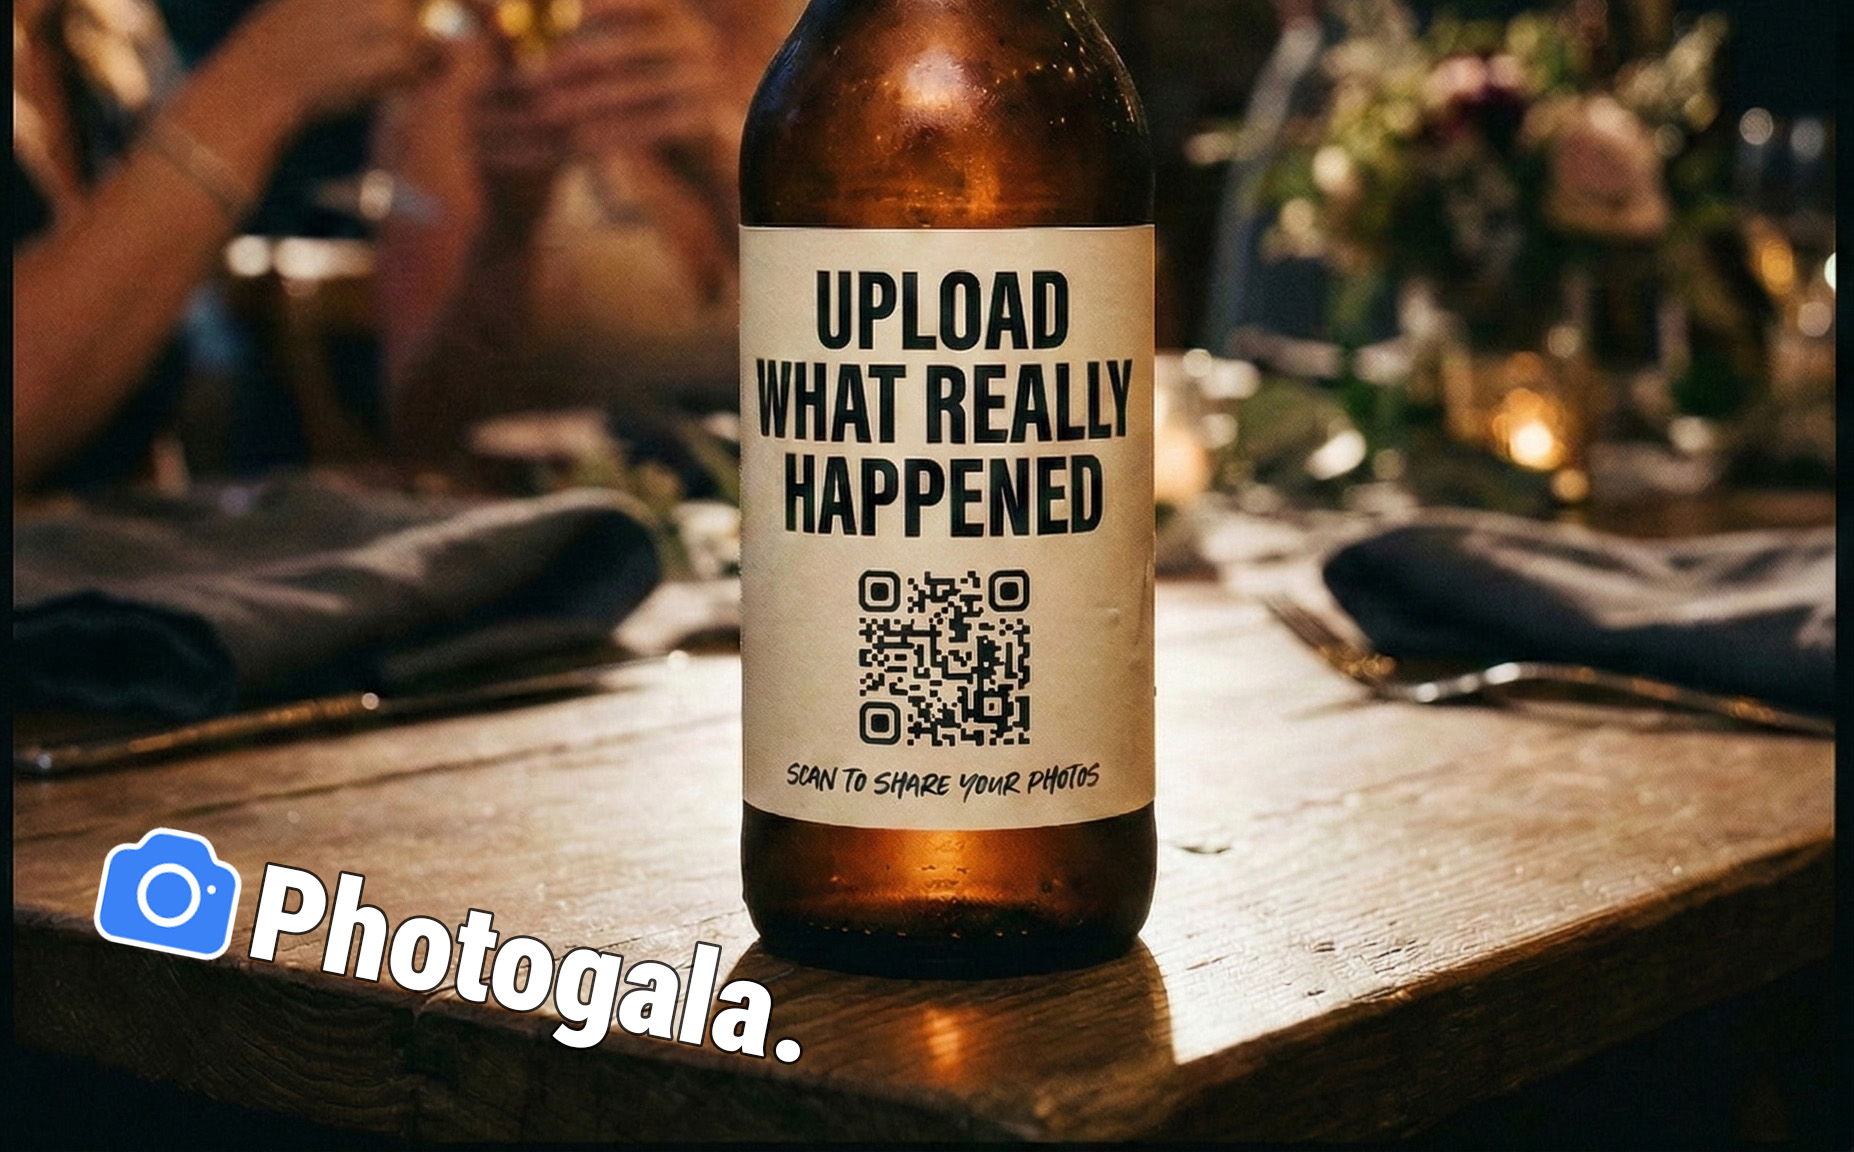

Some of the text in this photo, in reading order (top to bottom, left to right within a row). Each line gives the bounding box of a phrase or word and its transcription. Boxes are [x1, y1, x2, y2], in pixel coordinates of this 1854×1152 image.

[816, 270, 1069, 351] UPLOAD
[756, 358, 1133, 445] WHAT REALLY
[785, 452, 1103, 538] HAPPENED
[786, 762, 1101, 804] SCAN TO SHARE YOUR PHOTOS
